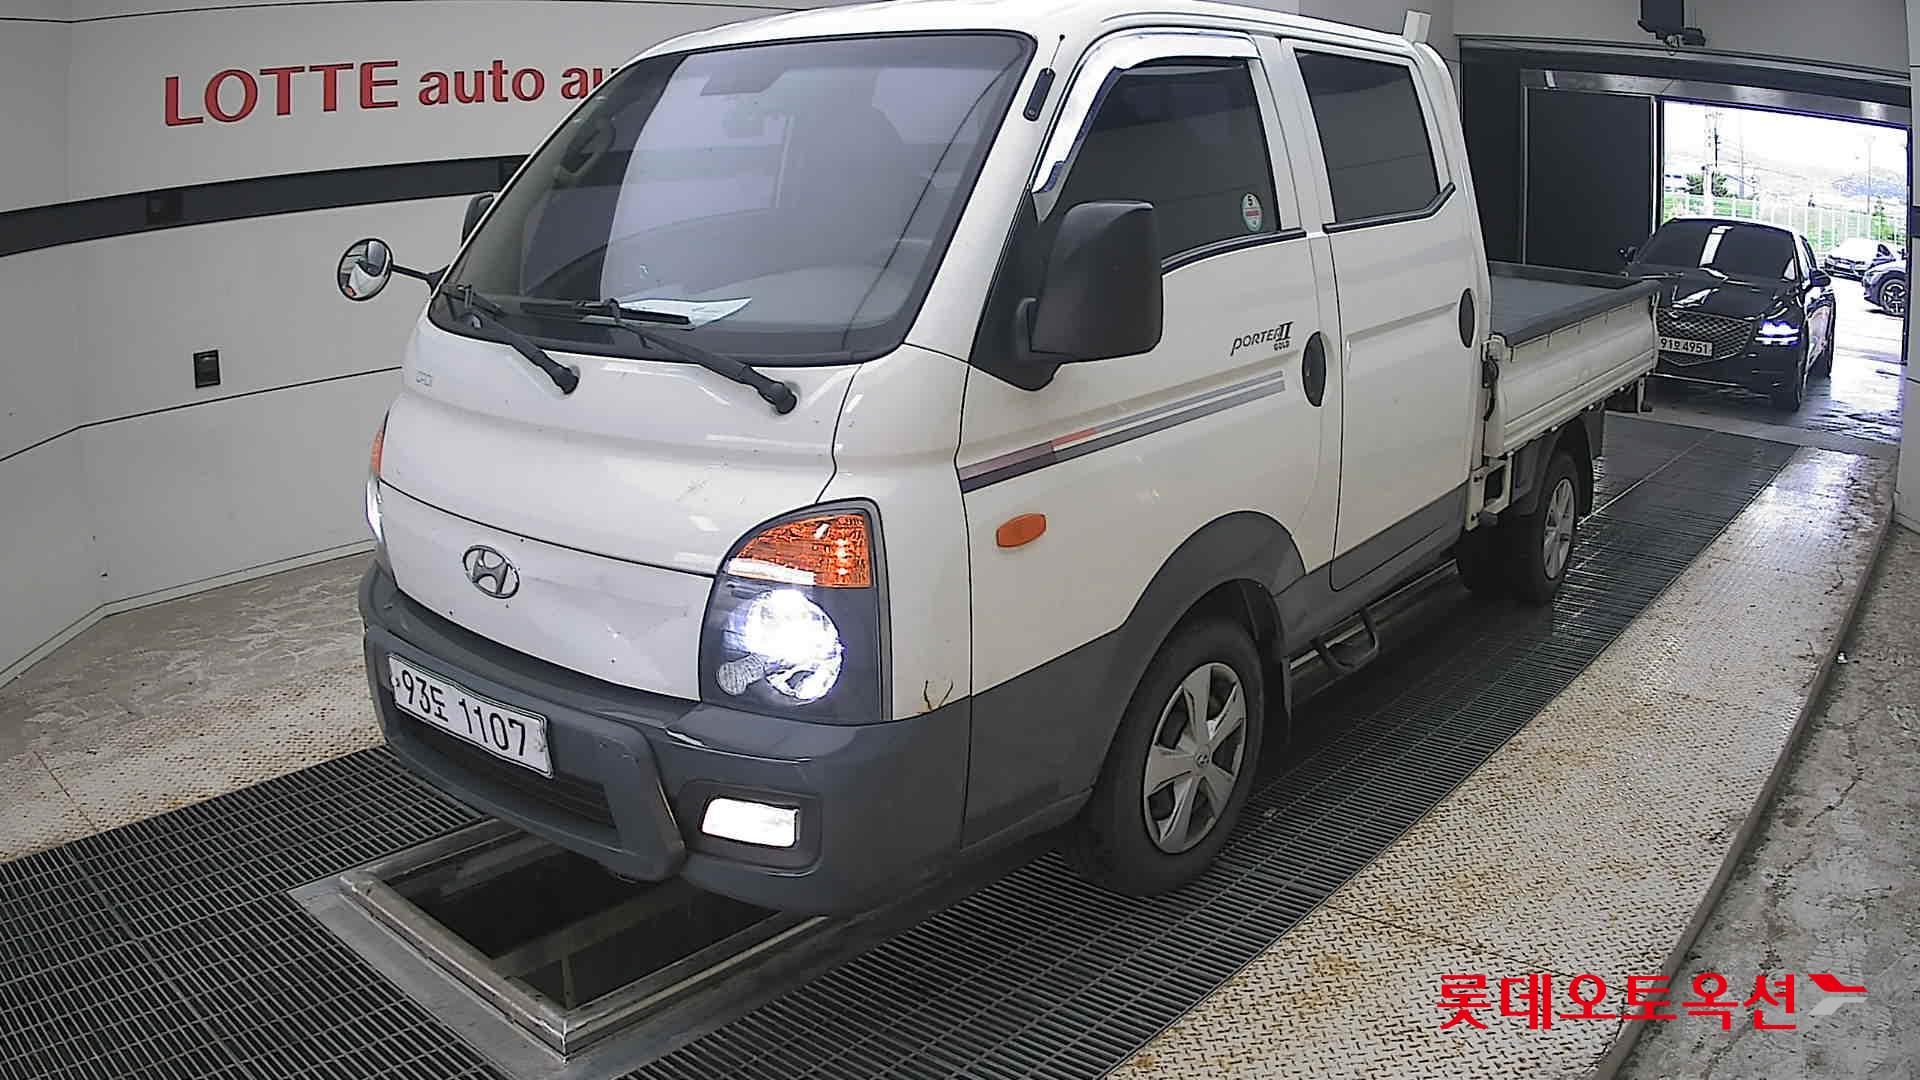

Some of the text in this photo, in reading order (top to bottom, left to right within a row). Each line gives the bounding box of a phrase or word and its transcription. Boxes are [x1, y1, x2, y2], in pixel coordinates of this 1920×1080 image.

[164, 60, 399, 127] LOTTE
[418, 58, 546, 106] auto
[1682, 340, 1708, 355] 4951
[401, 669, 526, 757] 93도 1107
